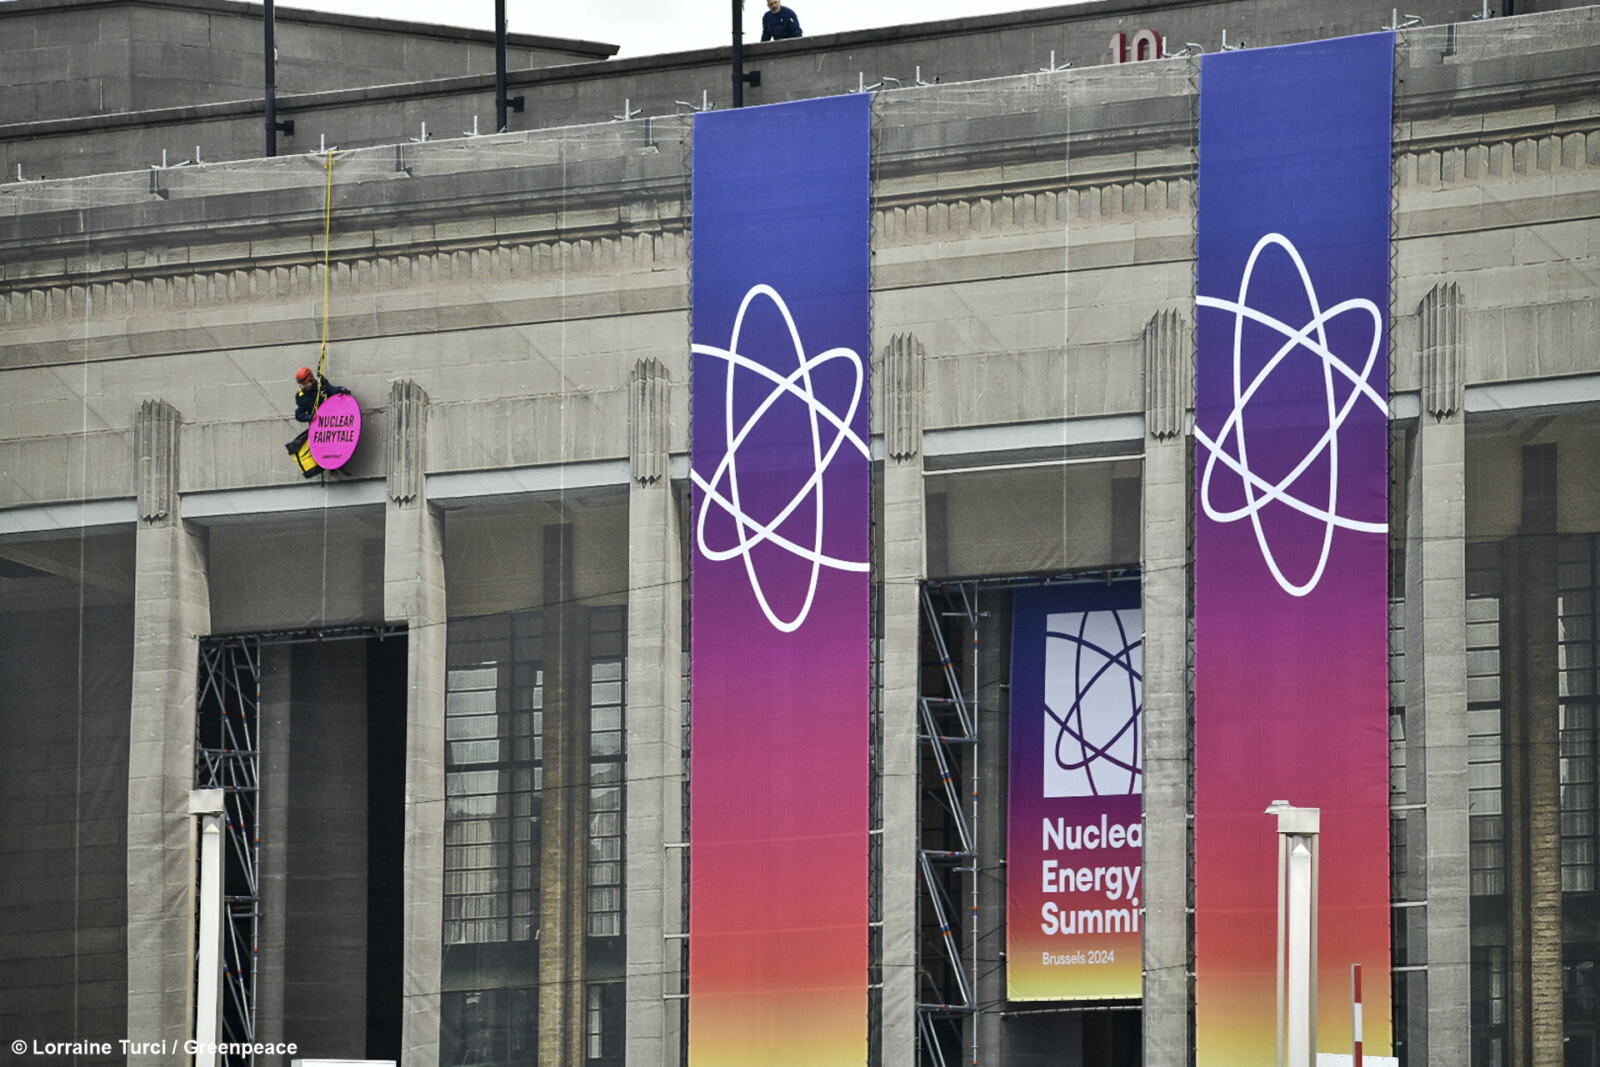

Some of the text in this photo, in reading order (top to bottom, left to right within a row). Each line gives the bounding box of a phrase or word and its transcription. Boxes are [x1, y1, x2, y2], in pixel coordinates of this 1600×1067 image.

[318, 415, 355, 428] NUCLEAR
[313, 430, 355, 444] FAIRYTALE
[1042, 814, 1142, 851] Nuclea
[1042, 860, 1141, 900] Energy
[1041, 897, 1142, 935] Summi
[1042, 950, 1115, 965] Brussels 2024
